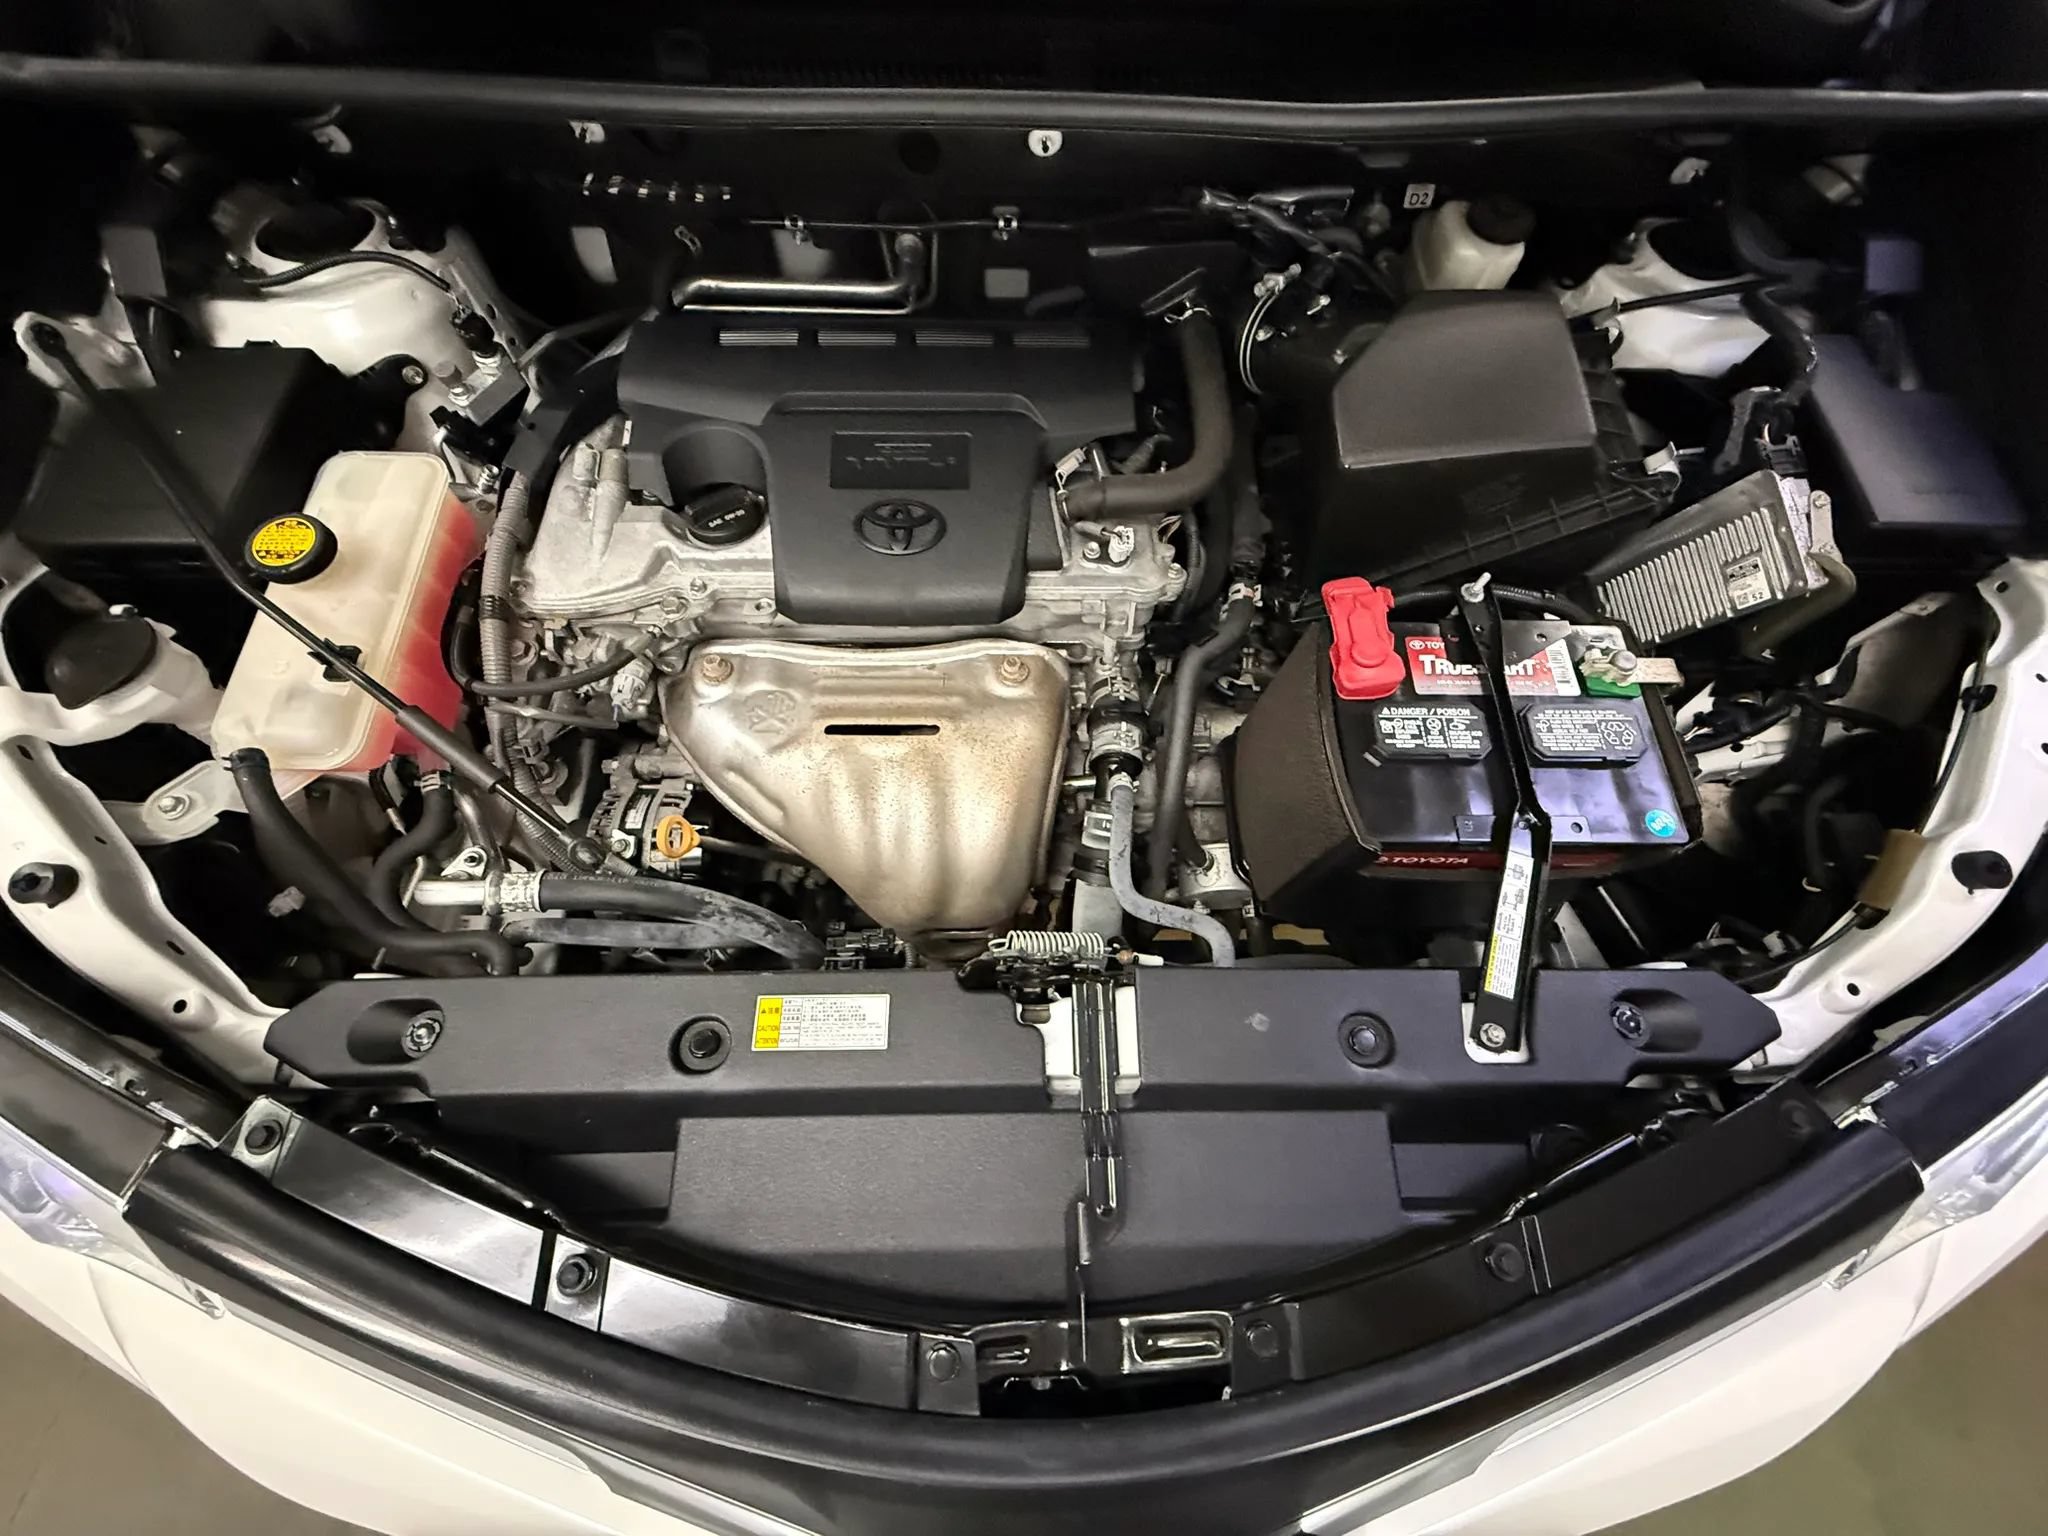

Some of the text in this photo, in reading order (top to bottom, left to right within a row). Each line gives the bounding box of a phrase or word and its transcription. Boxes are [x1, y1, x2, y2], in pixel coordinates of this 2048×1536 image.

[1409, 192, 1429, 206] D2
[708, 518, 723, 527] SAE
[1751, 592, 1764, 601] 52
[1425, 641, 1445, 649] TOY
[1390, 706, 1428, 716] DANGER
[1436, 707, 1471, 717] POISON
[1392, 856, 1469, 864] TOYOTA
